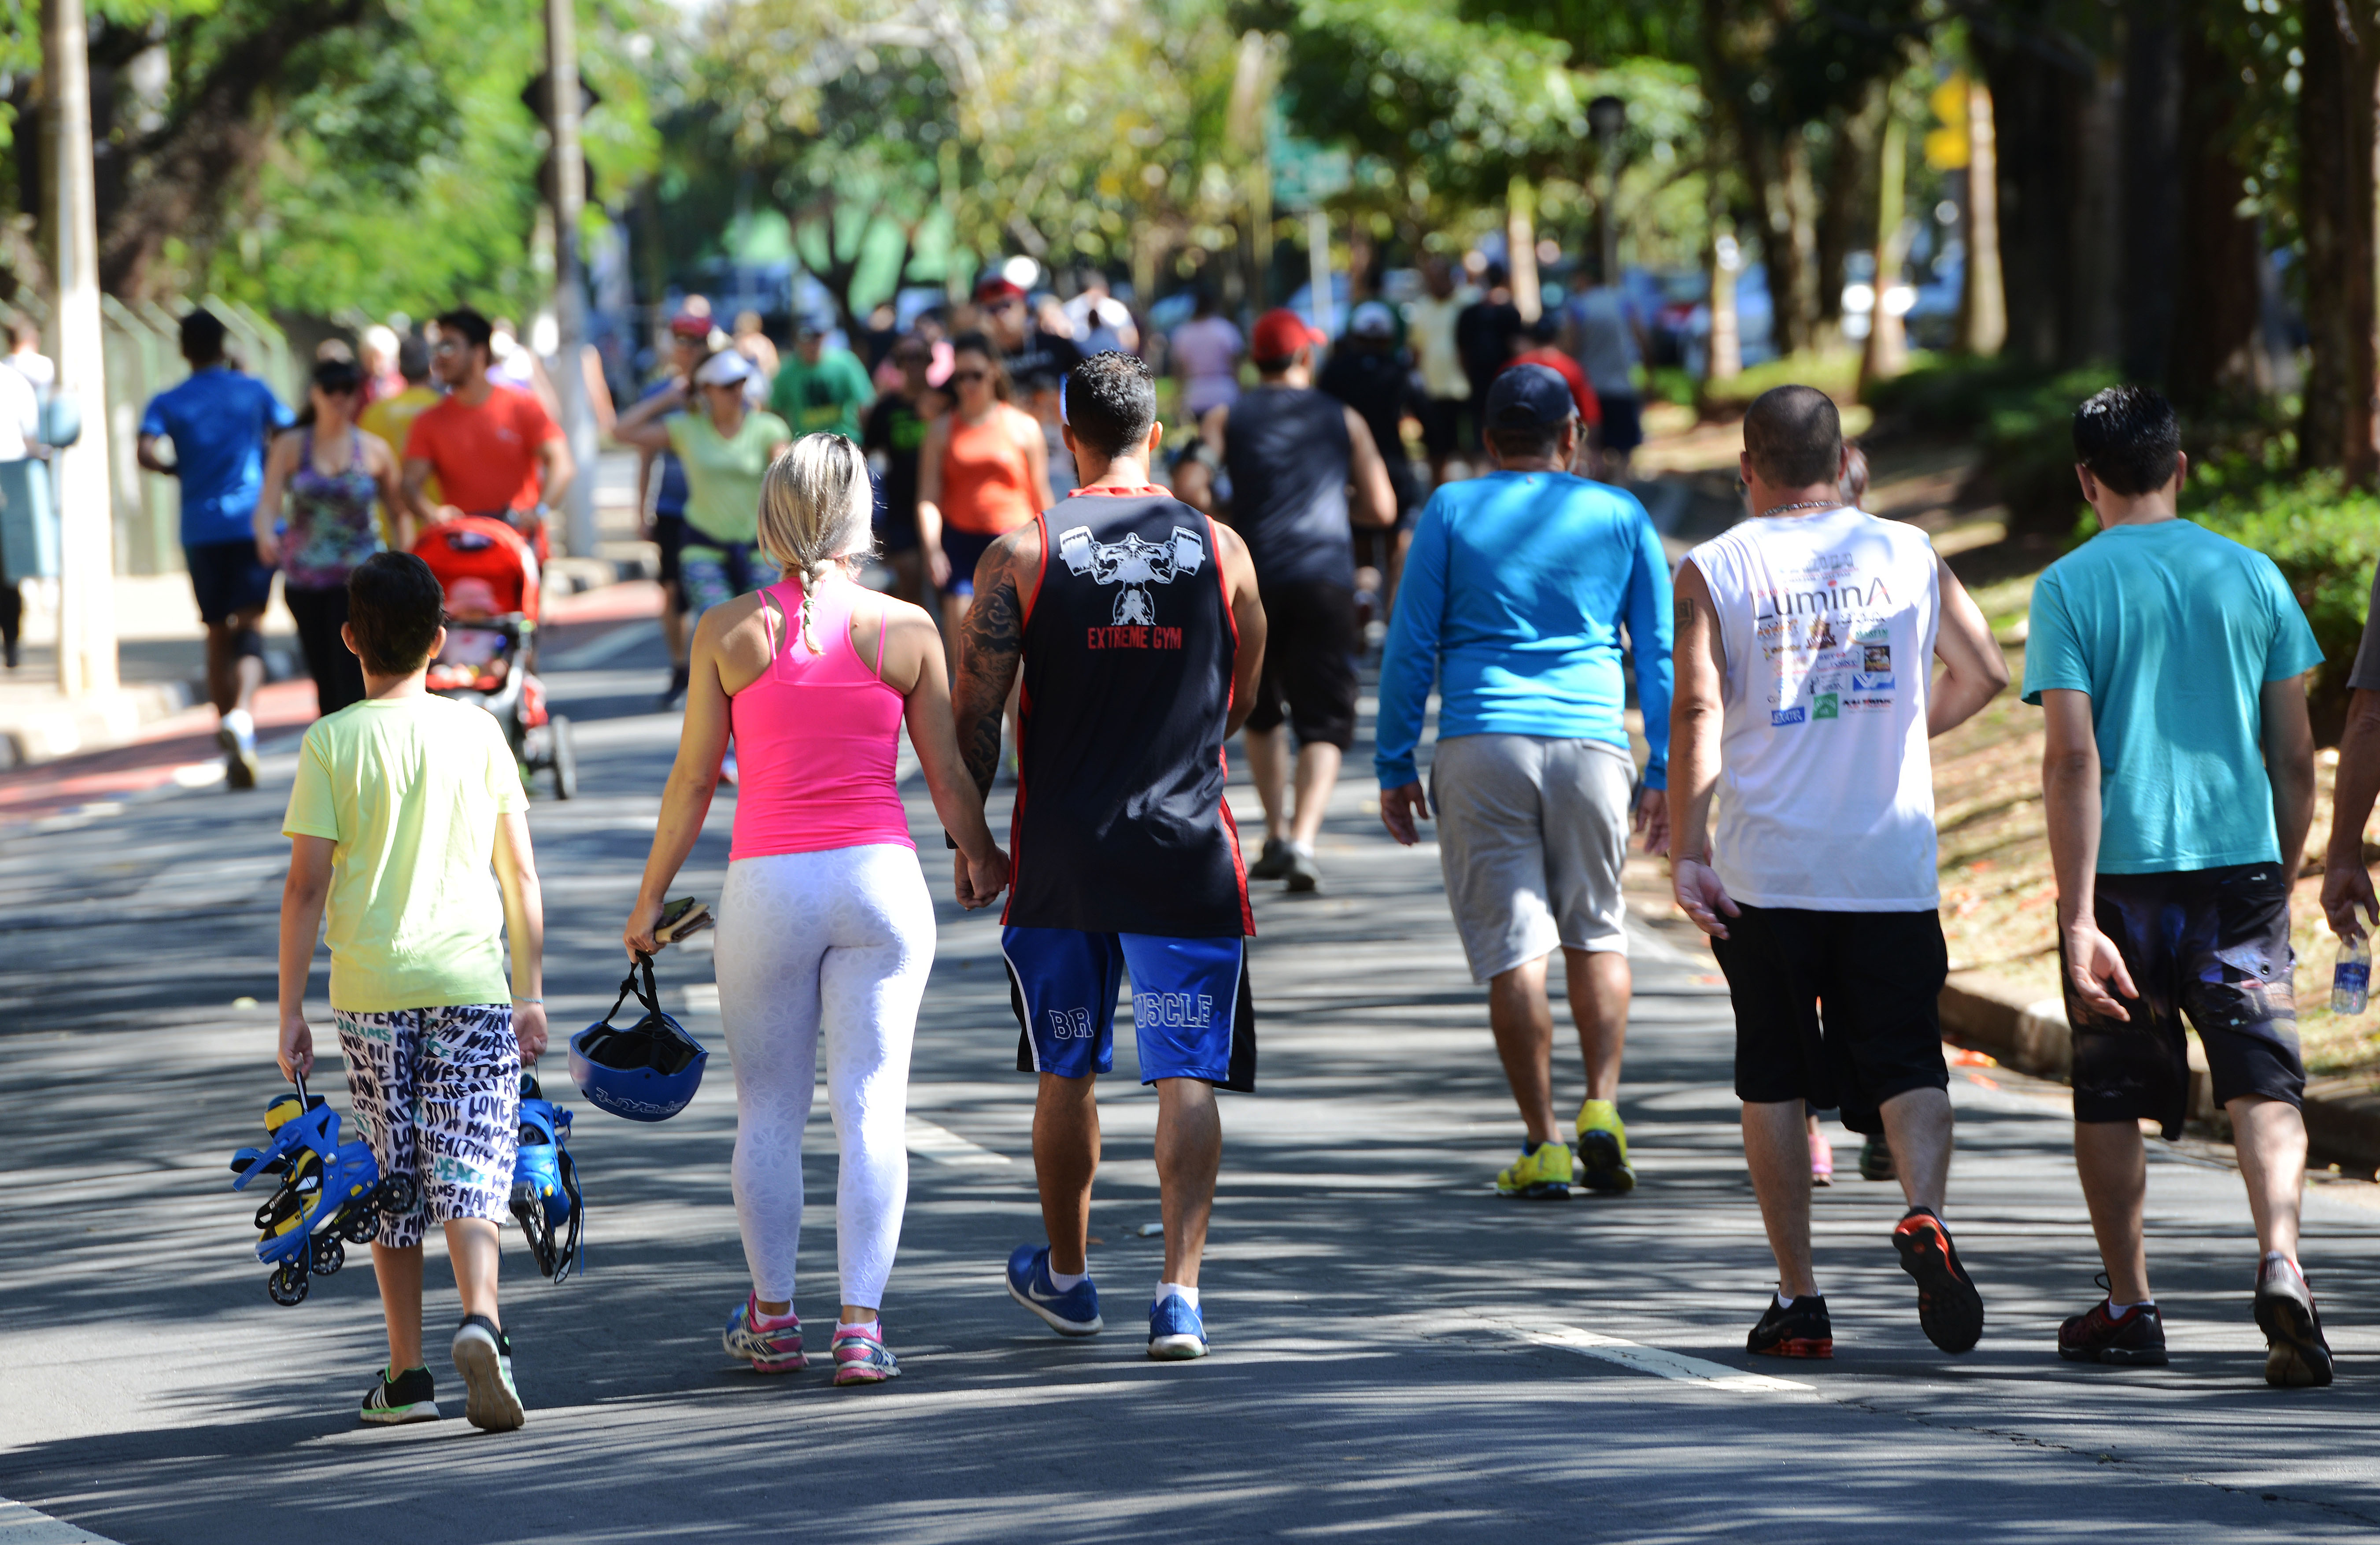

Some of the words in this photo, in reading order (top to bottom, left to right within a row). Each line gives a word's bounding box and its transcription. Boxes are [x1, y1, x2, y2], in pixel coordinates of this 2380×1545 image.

[1087, 627, 1148, 649] EXTREME
[1153, 627, 1182, 649] GYM
[337, 1017, 392, 1042] DREAMS
[1049, 1007, 1093, 1039] BR
[469, 1096, 510, 1123] LOVE
